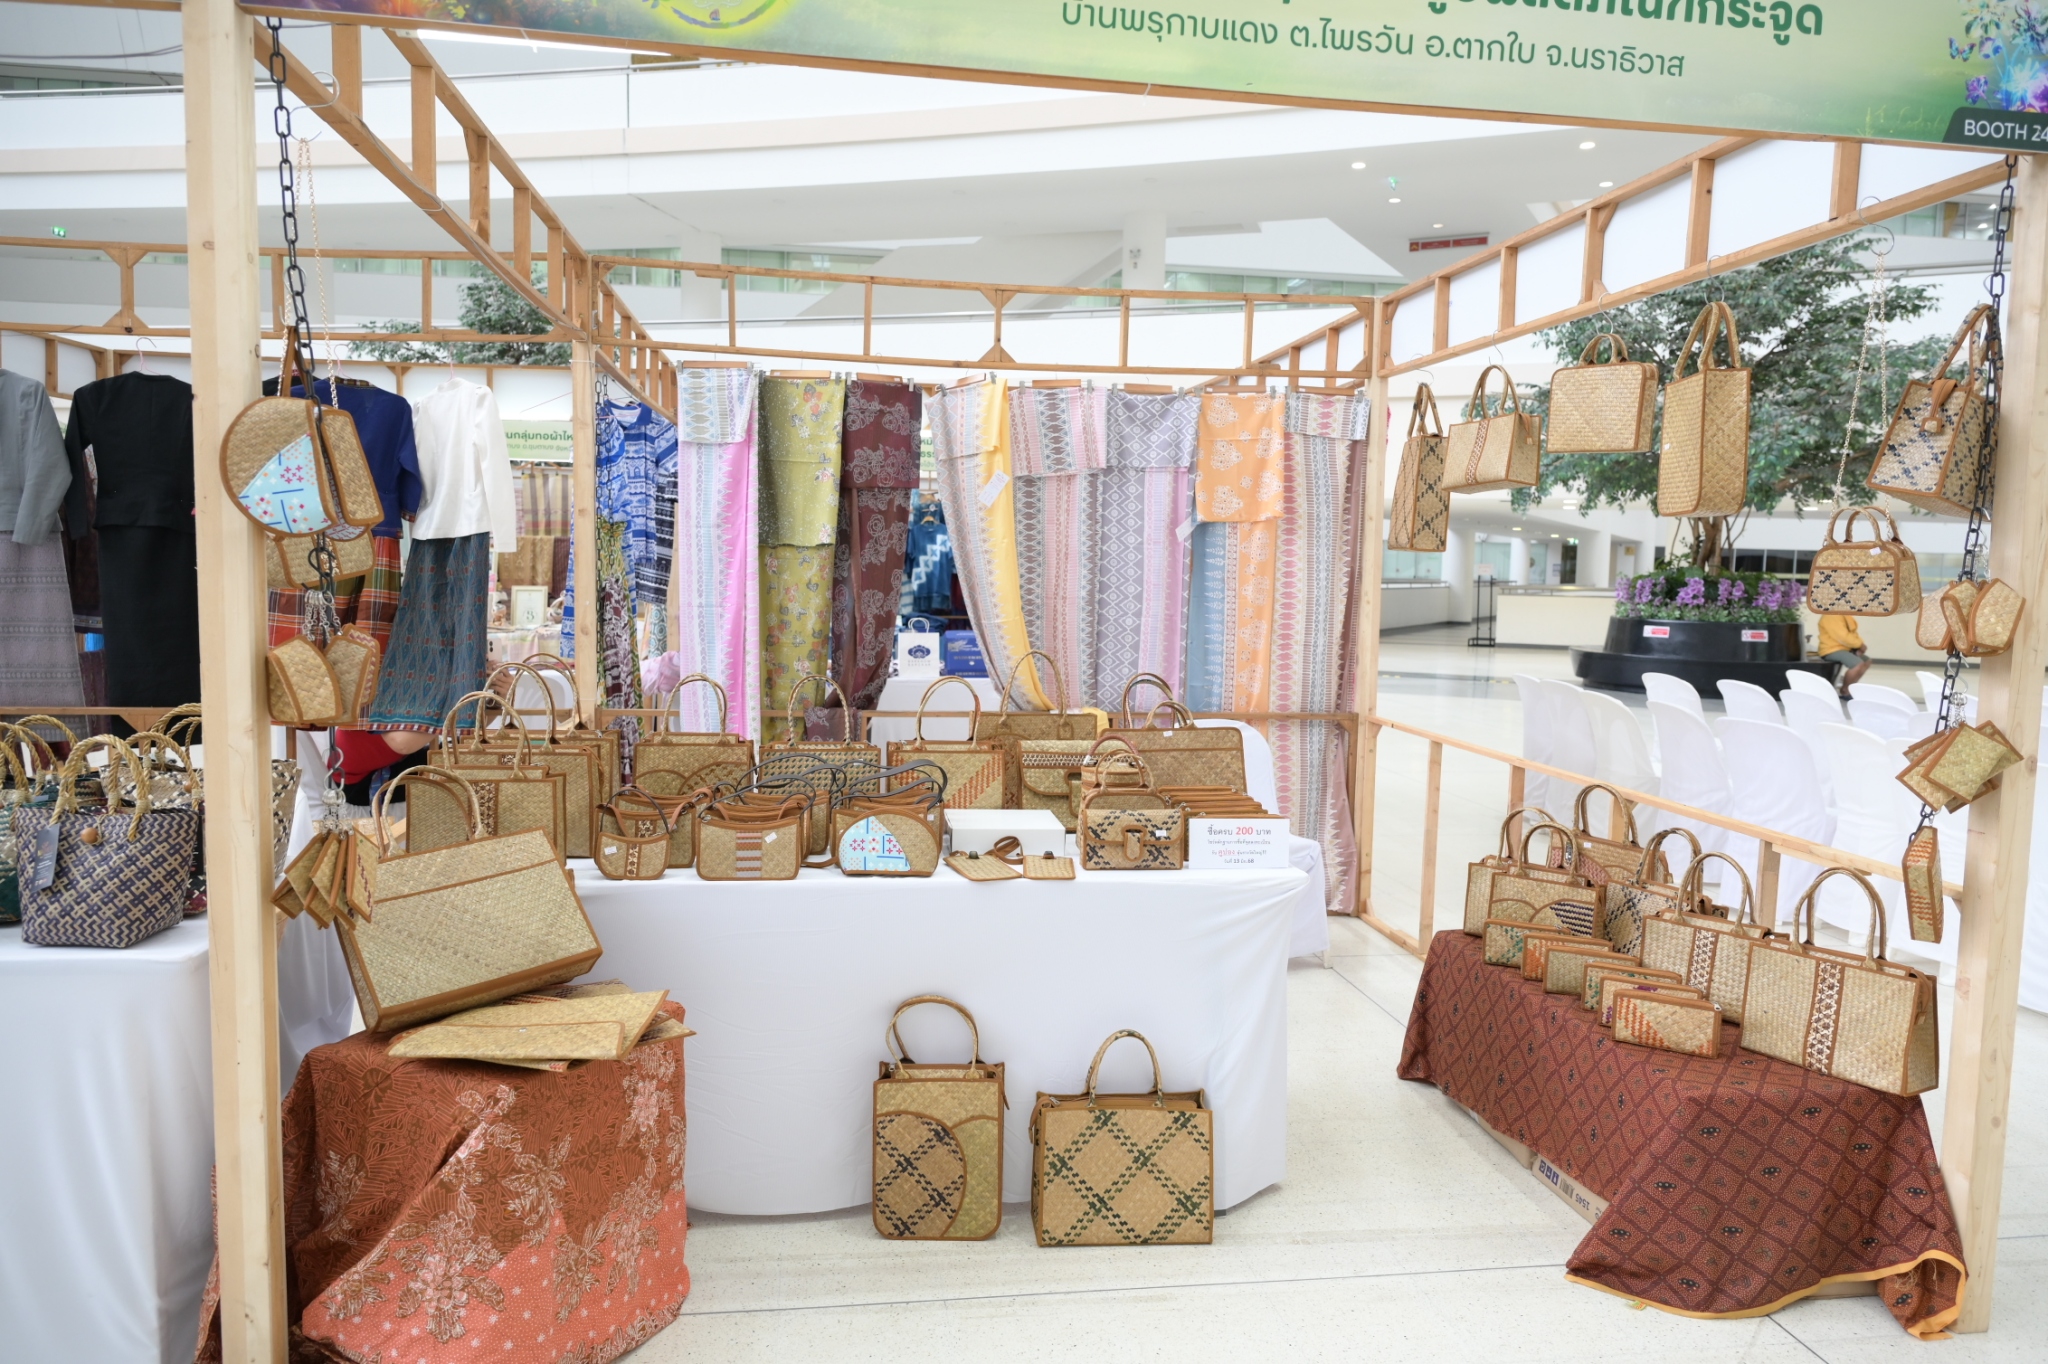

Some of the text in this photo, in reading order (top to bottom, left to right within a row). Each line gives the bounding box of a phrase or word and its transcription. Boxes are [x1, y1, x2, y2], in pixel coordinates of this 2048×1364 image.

[1062, 0, 1686, 78] บานพรุกาบแดง ต.ไพรวัน อ.ตากใบ จ.นราธิวาส
[1964, 119, 2028, 141] BOOTH
[1207, 824, 1233, 835] ซื้อครบ
[1235, 826, 1253, 835] 200
[1218, 848, 1236, 857] คูปอง
